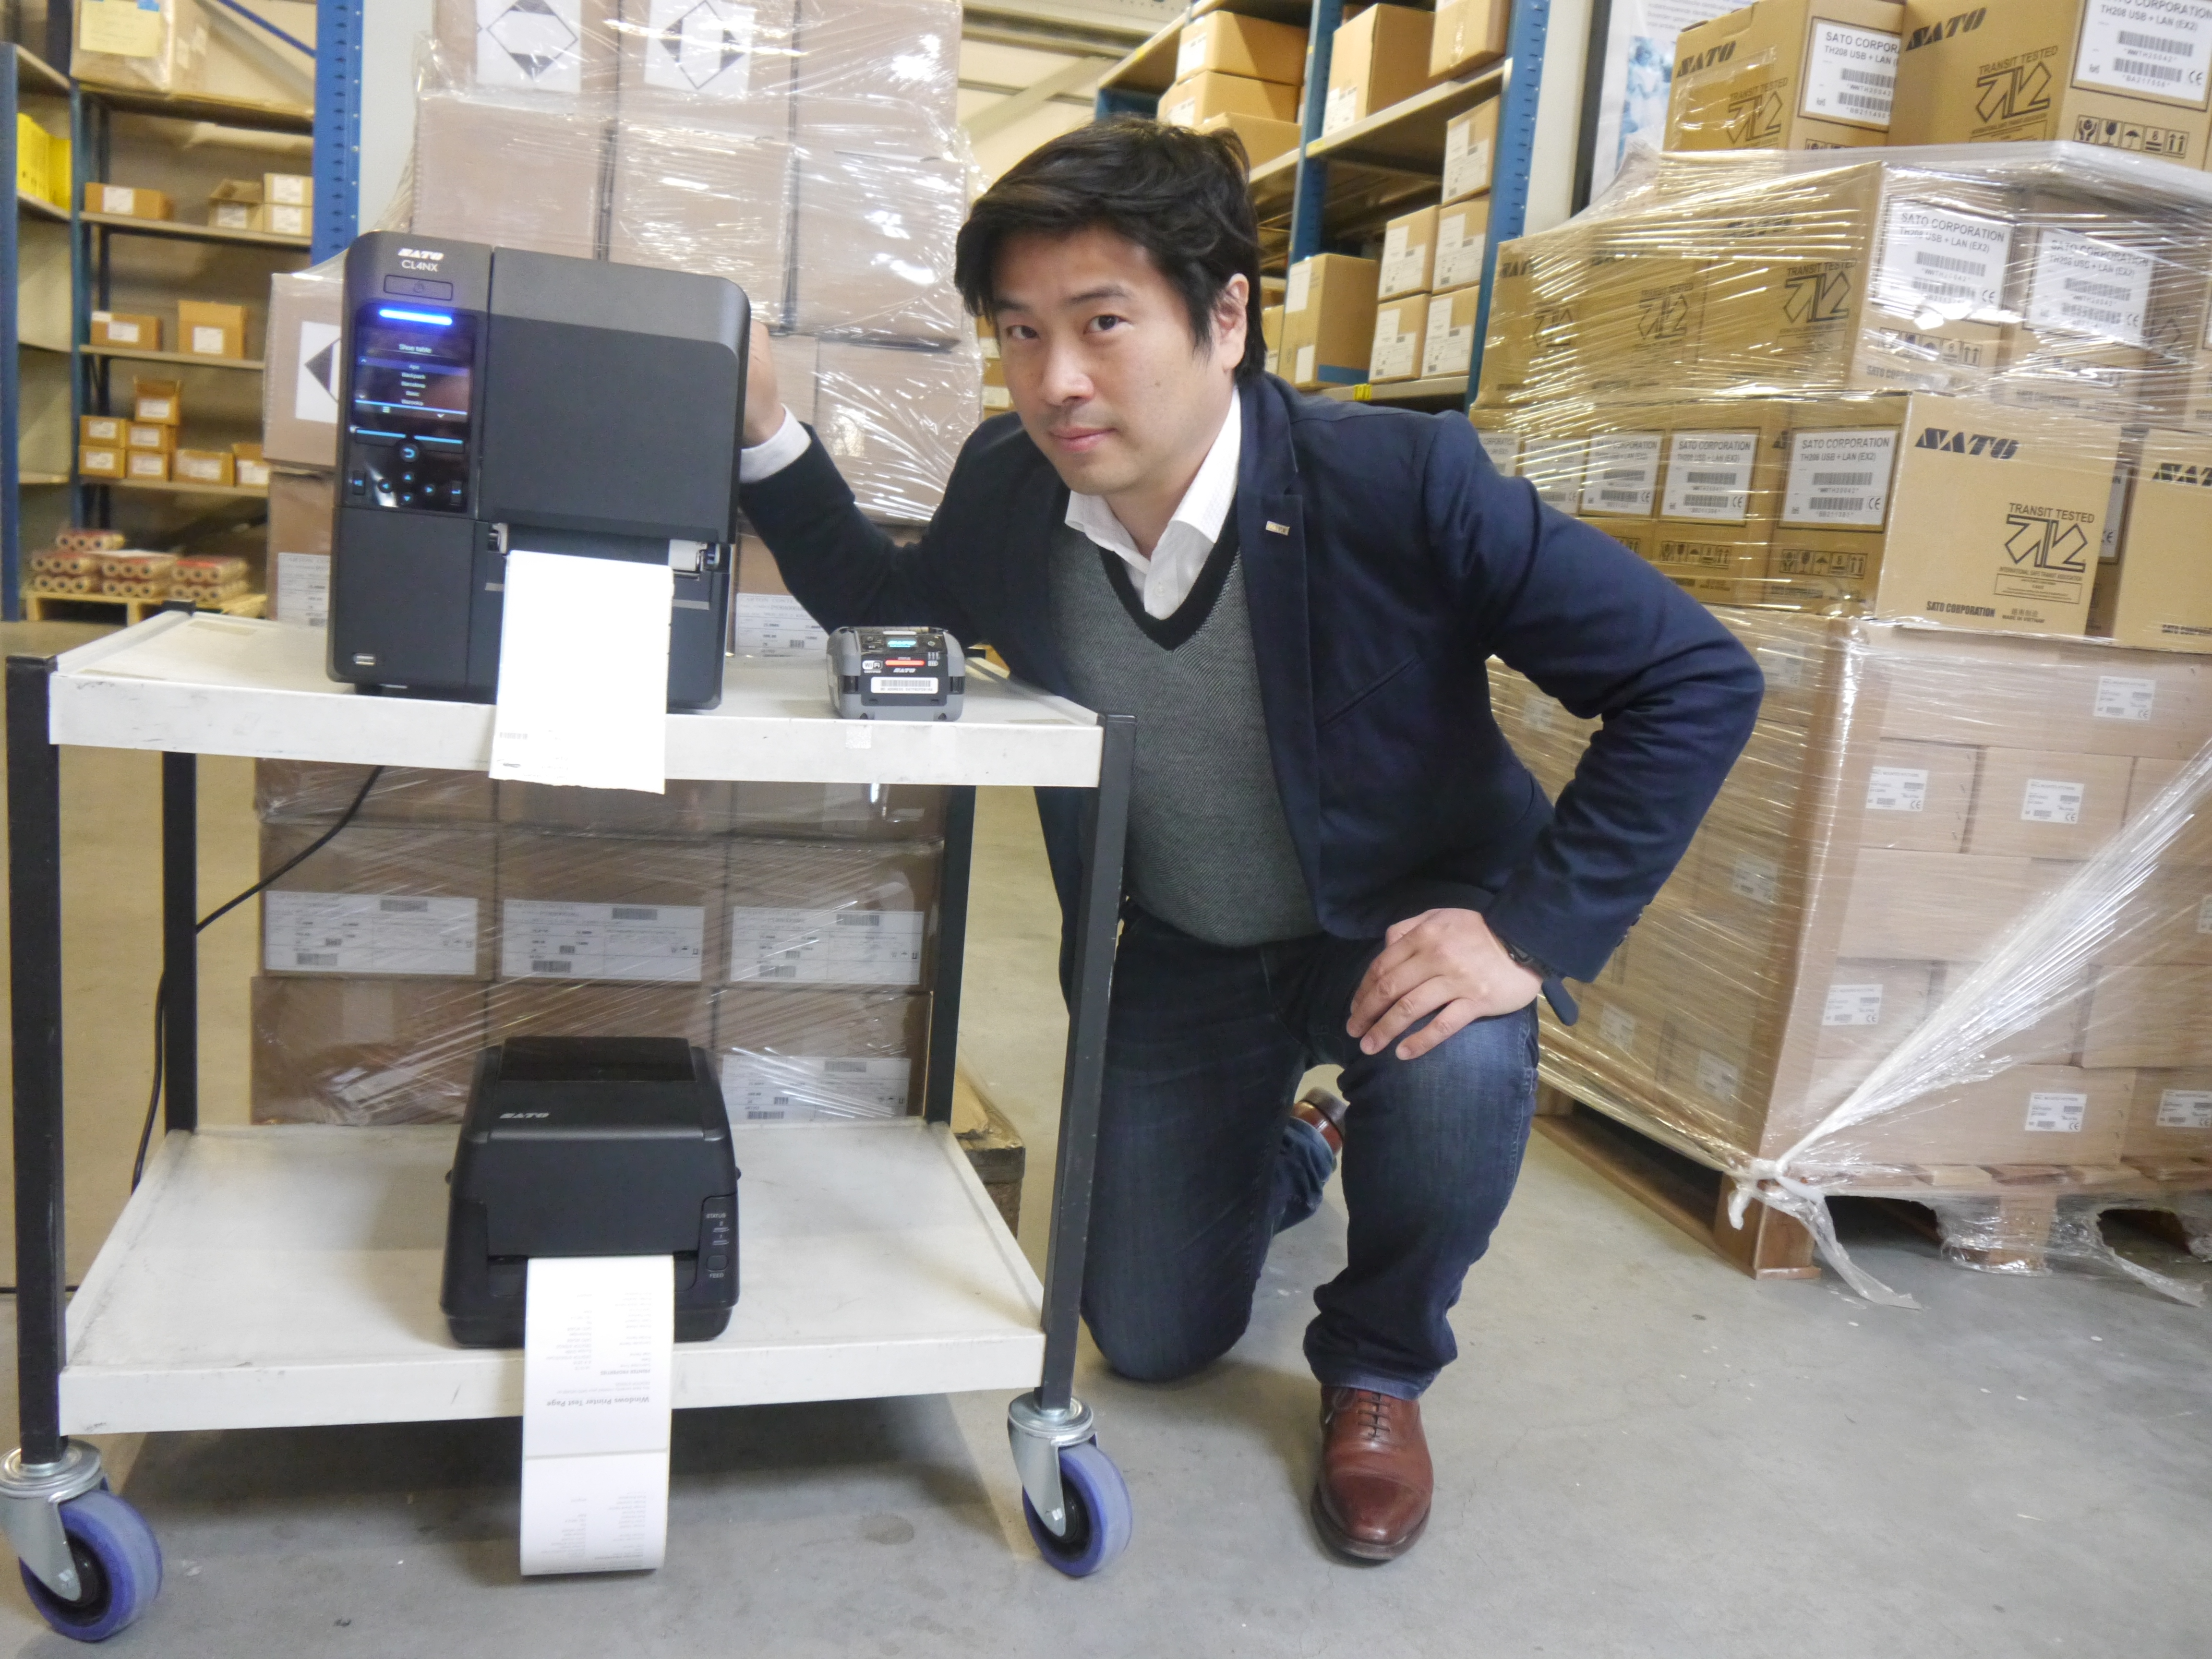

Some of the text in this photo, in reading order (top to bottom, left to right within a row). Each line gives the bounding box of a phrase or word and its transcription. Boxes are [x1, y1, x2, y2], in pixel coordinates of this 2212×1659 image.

[2128, 10, 2147, 21] USB
[2155, 16, 2174, 26] LAN
[1906, 7, 1986, 51] SATO
[1826, 31, 1852, 45] SATO
[1676, 40, 1735, 78] SATO
[1825, 45, 1848, 56] TH208
[1850, 50, 1866, 60] USB
[1875, 55, 1891, 64] LAN
[1979, 45, 2058, 74] TRANSIT TESTED
[1901, 213, 2005, 242] SATO CORPORATION
[1925, 232, 1942, 242] USB
[1951, 237, 1967, 248] LAN
[1969, 240, 1989, 254] (EX2)
[397, 248, 445, 261] SATO
[401, 259, 438, 272] CL4NX
[1788, 263, 1821, 276] TRANSIT
[1679, 441, 1751, 451] SATO CORPORATION
[1802, 437, 1890, 449] SATO CORPORATION
[1915, 427, 2020, 459] SATO
[1821, 453, 1835, 461] USB
[1842, 453, 1856, 461] LAN
[1858, 452, 1876, 462] (EX2)
[2009, 503, 2095, 523] TRANSIT TESTED
[1926, 601, 1996, 618] SATO CORPORATION
[1910, 800, 1921, 810] CE
[2065, 813, 2077, 821] CE
[546, 1399, 566, 1407] Page
